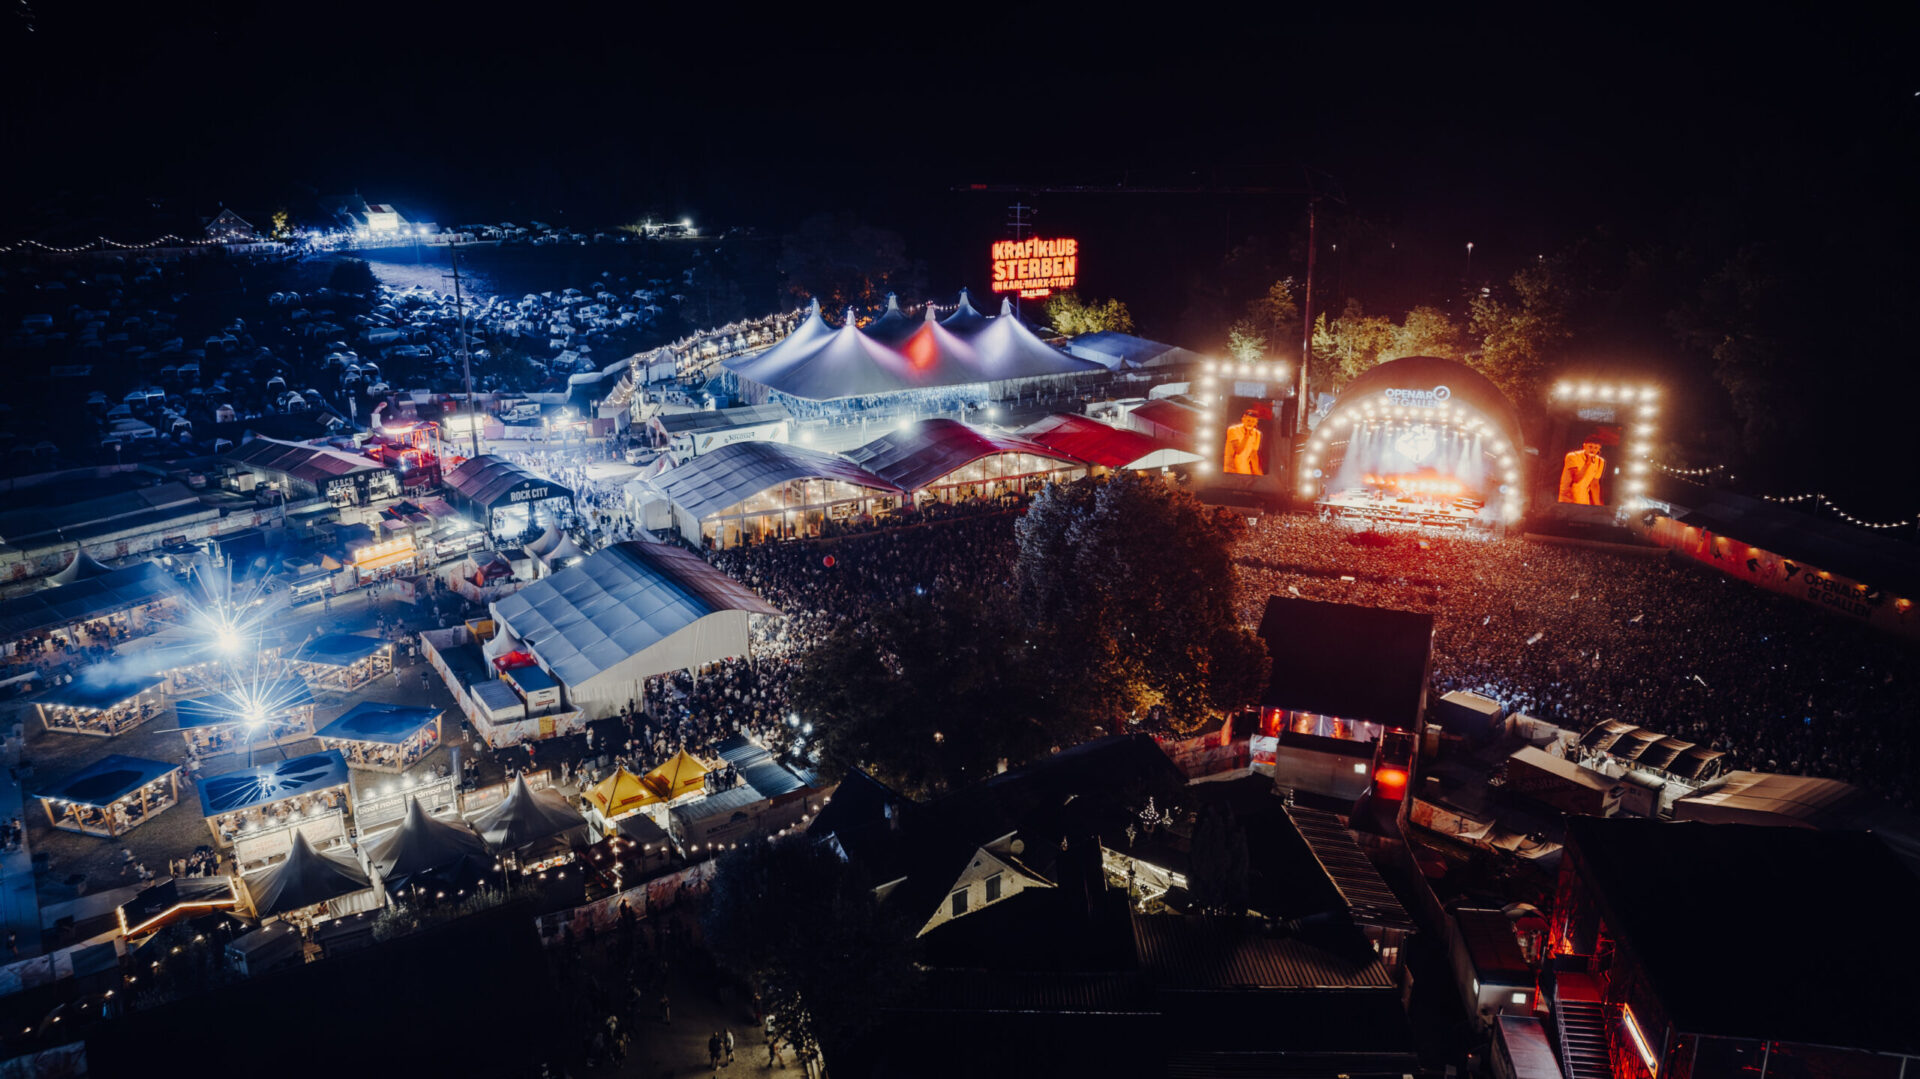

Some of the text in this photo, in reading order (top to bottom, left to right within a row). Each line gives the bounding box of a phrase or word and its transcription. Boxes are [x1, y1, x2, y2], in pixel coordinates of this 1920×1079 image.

[994, 257, 1076, 281] STERBEN
[328, 470, 391, 489] MERCH SHOP
[510, 487, 549, 502] ROCK CITY
